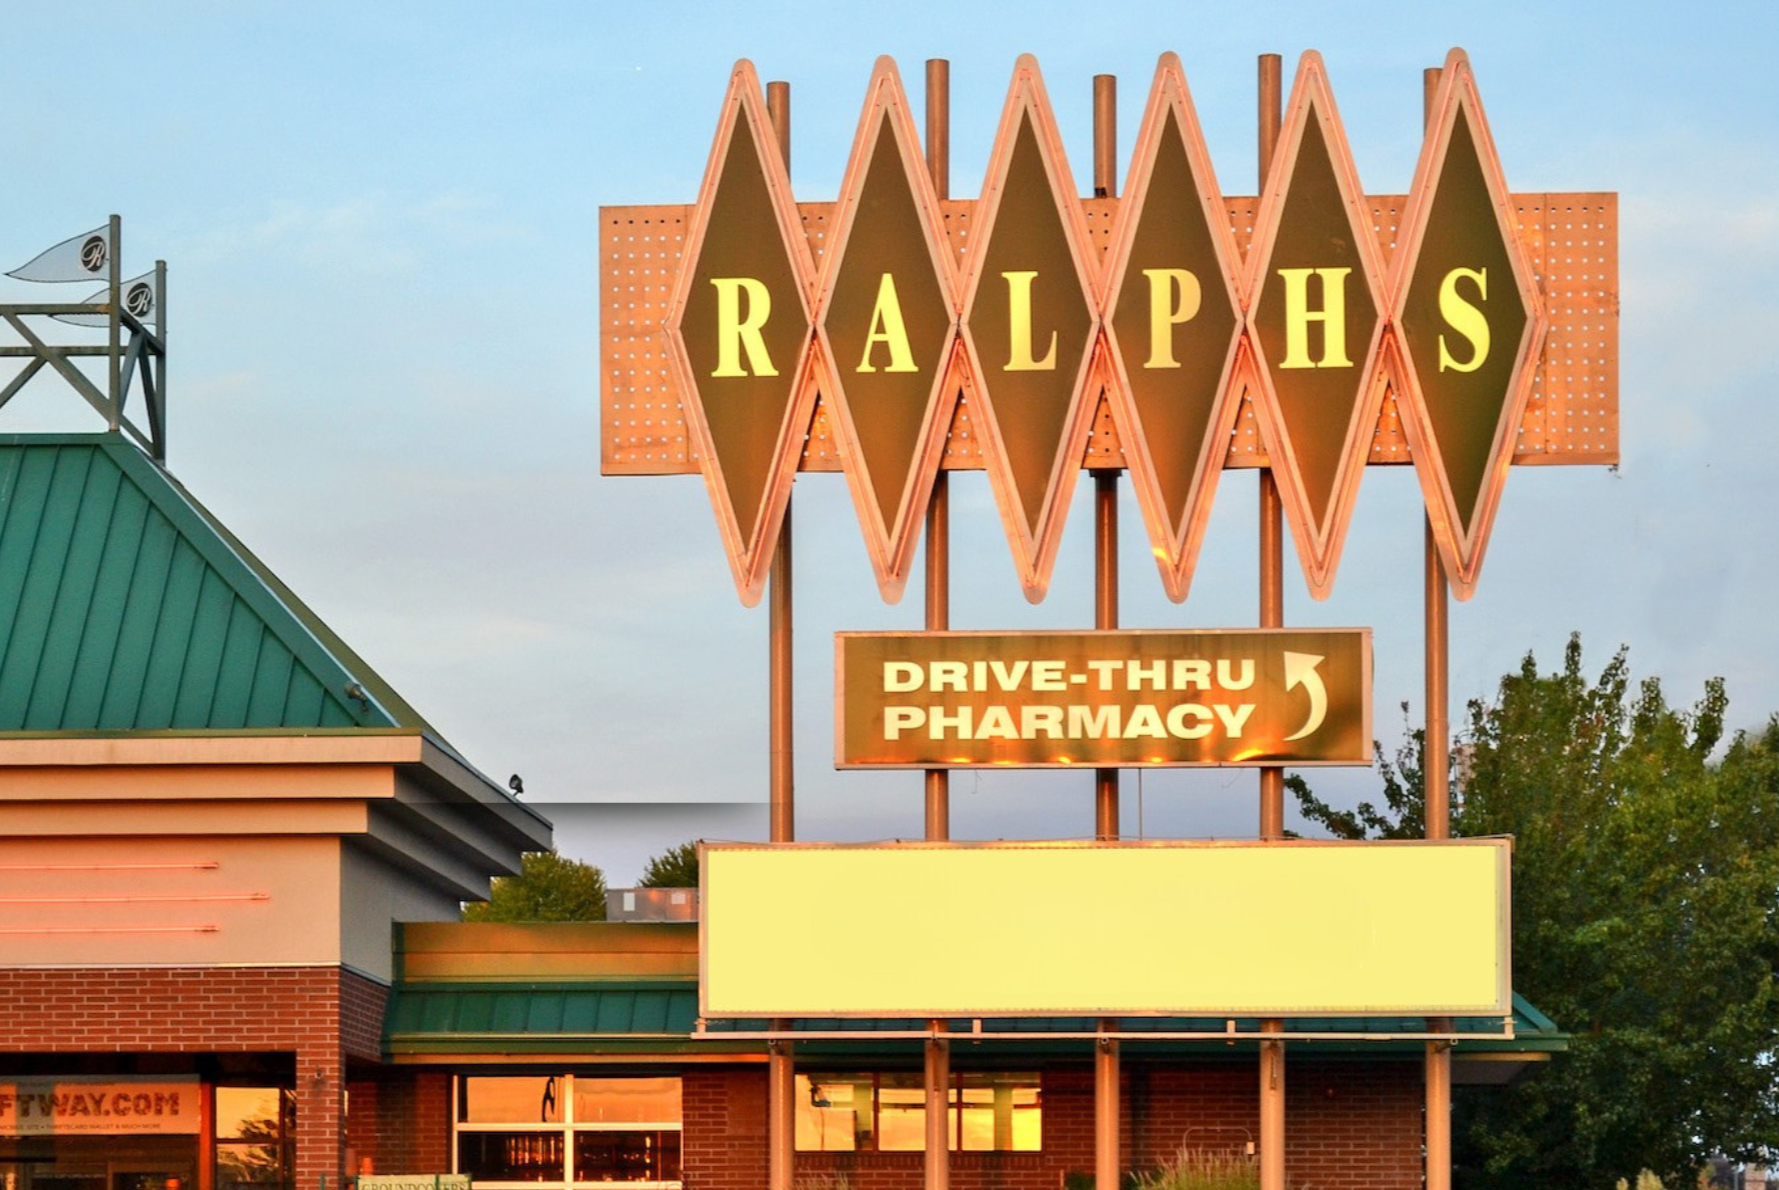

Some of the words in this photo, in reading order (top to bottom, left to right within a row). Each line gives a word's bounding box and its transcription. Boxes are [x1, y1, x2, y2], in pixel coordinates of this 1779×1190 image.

[710, 267, 1490, 377] RALPHS
[883, 659, 1256, 693] DRIVE-THRU
[883, 703, 1256, 741] PHARMACY
